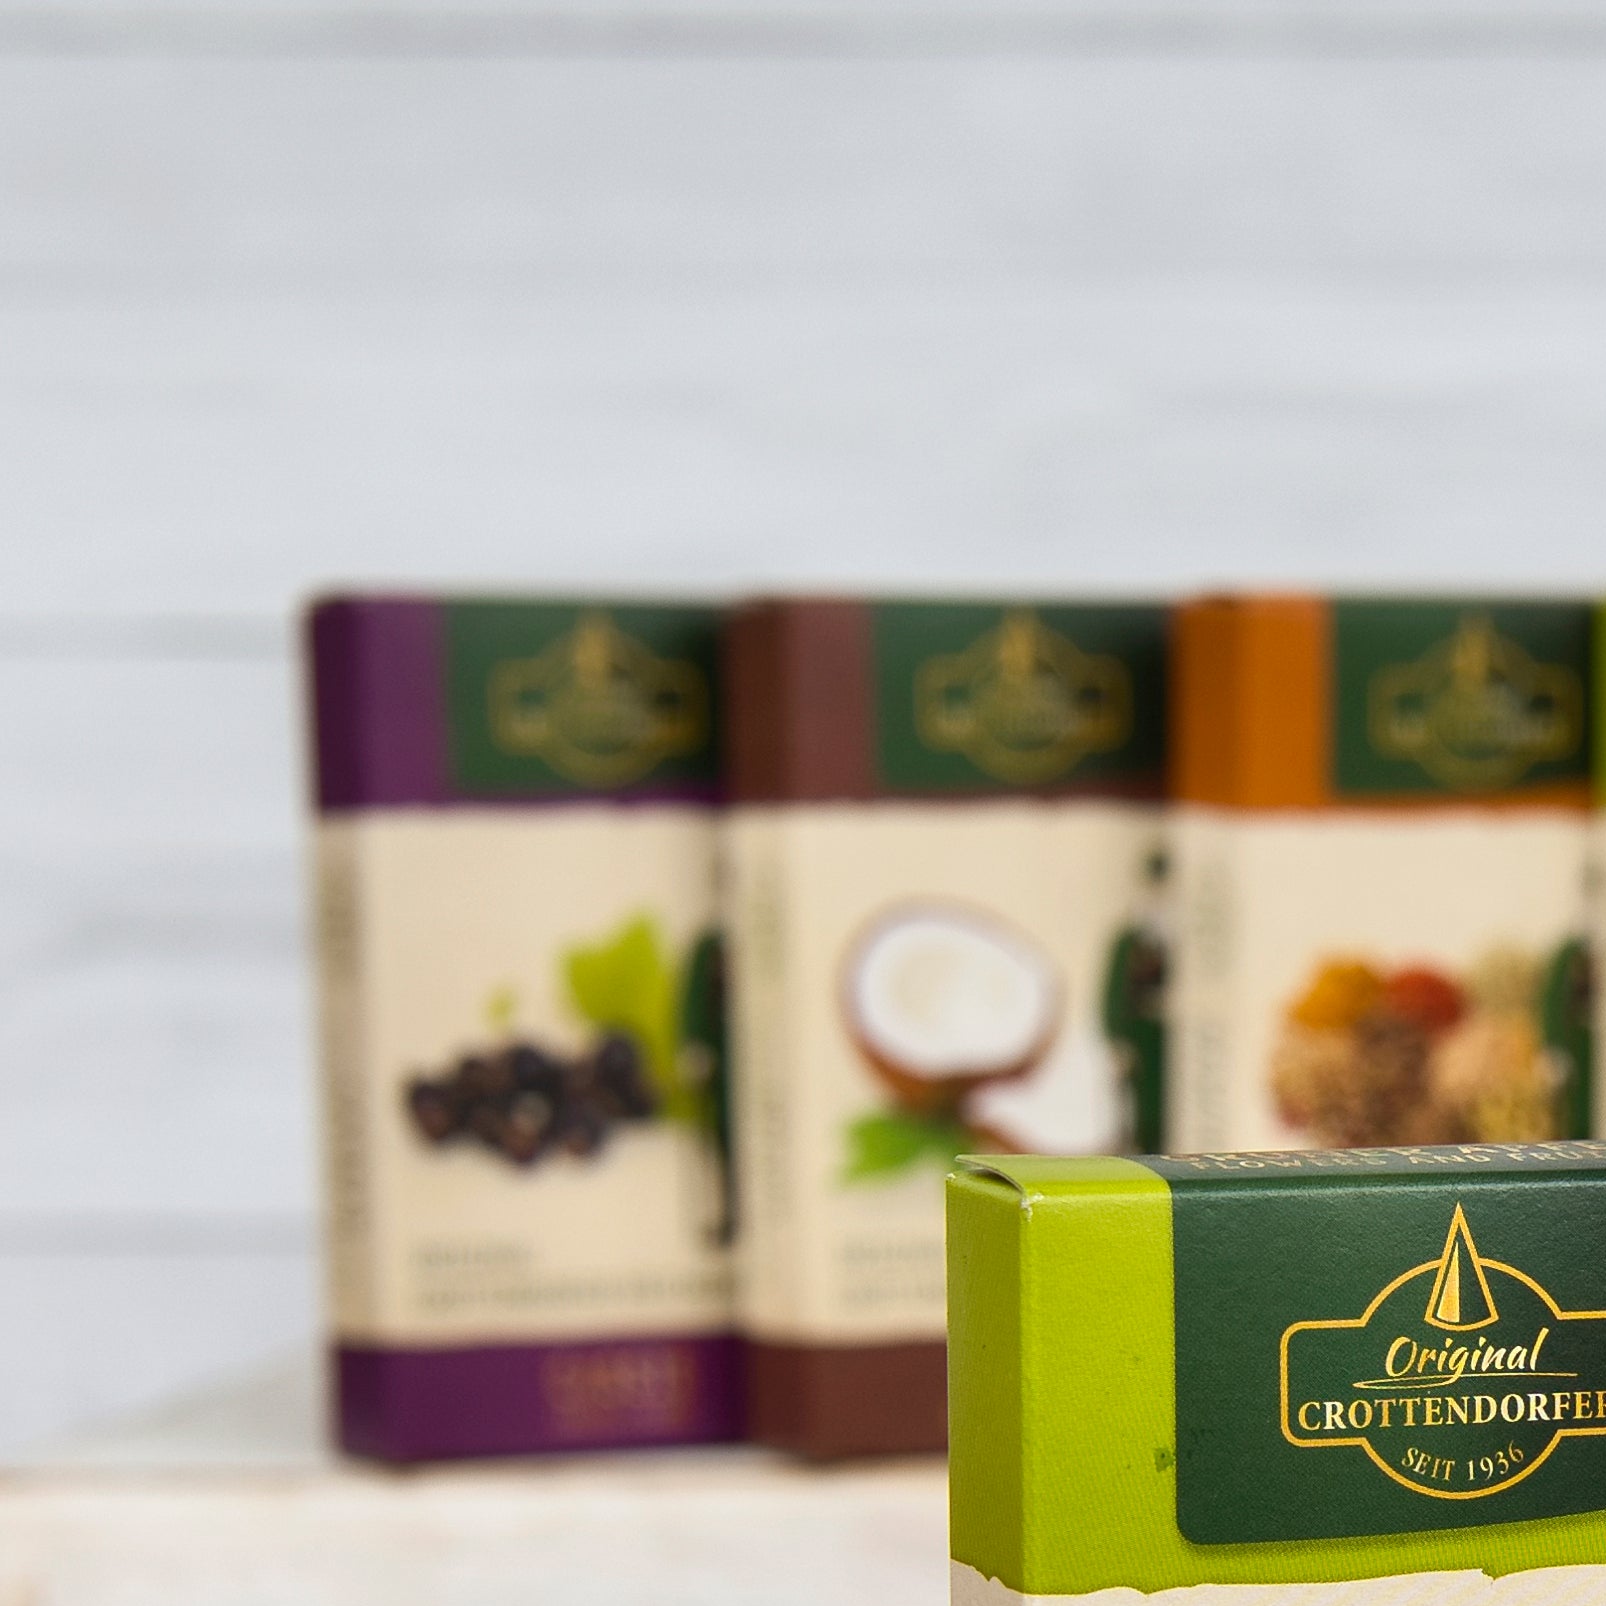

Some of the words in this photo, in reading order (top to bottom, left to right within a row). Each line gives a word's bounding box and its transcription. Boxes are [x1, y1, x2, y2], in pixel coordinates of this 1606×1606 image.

[1409, 1154, 1491, 1165] AND
[1385, 1327, 1549, 1381] Original
[1401, 1447, 1455, 1481] SEIT
[1467, 1440, 1525, 1481] 1936
